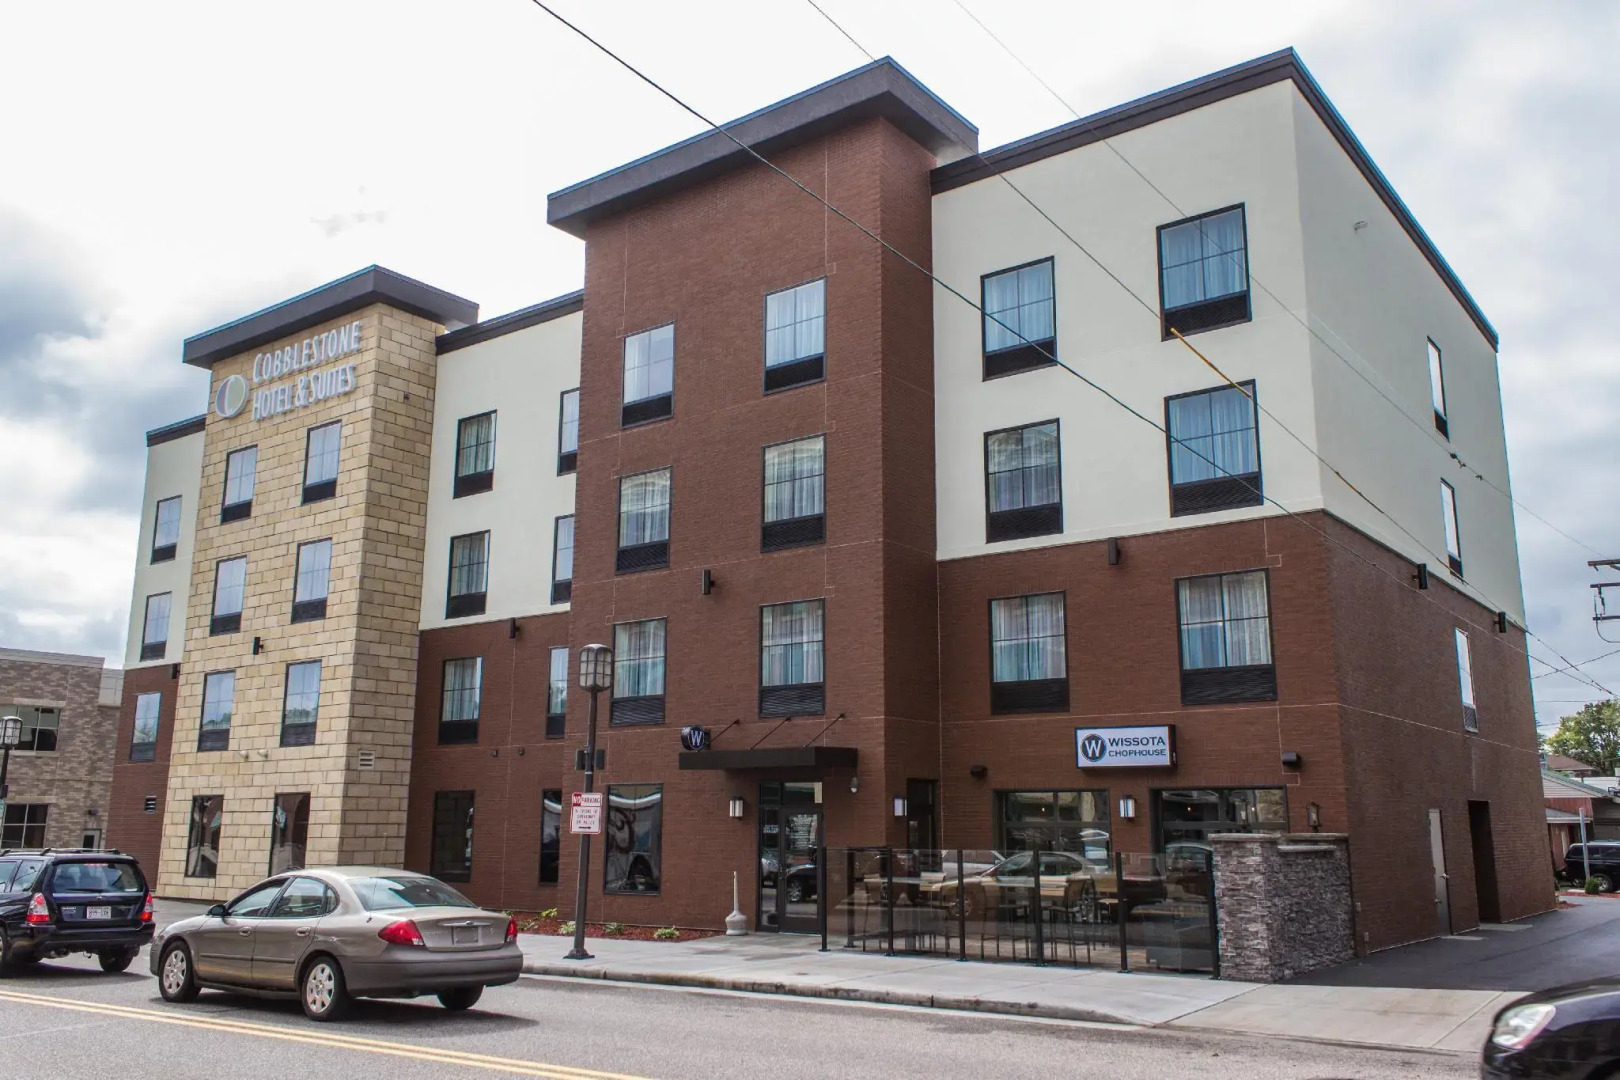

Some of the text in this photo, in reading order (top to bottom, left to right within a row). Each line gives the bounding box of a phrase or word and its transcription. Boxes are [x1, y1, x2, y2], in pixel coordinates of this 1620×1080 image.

[252, 321, 363, 384] COBBLESTONE
[252, 363, 357, 421] HOTEL & SUITES
[690, 730, 703, 746] W
[1108, 736, 1166, 747] WISSOTA
[1084, 740, 1102, 757] W
[1108, 748, 1167, 757] CHOPHOUSE
